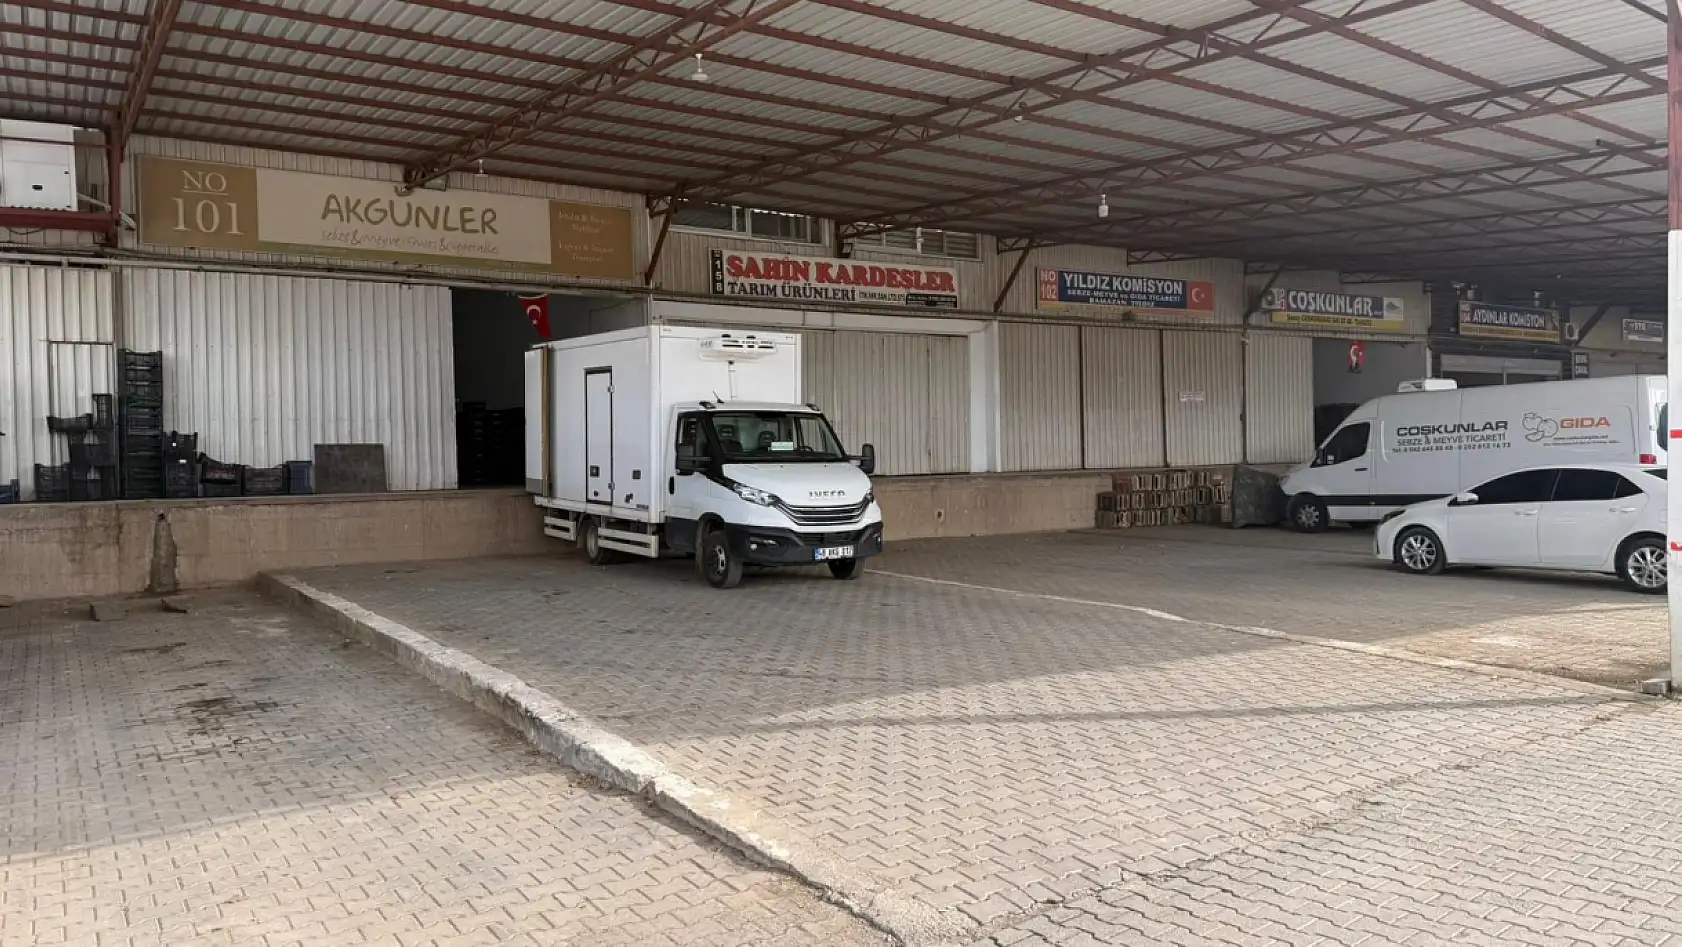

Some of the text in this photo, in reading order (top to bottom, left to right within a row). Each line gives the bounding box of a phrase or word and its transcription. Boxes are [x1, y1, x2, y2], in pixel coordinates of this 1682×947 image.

[181, 170, 227, 191] NO
[172, 197, 244, 235] 101
[1040, 271, 1055, 281] NO
[1064, 272, 1183, 295] YILDIZ KOMİSYON
[728, 281, 777, 297] TARIM
[781, 281, 856, 301] ÜRÜNLERİ
[1040, 283, 1057, 299] 102
[1473, 308, 1508, 324] AYDINLAR
[1560, 416, 1611, 428] GIDA
[1397, 438, 1422, 447] SEBZE
[1433, 436, 1462, 444] MEYVE
[809, 489, 846, 498] IVECO
